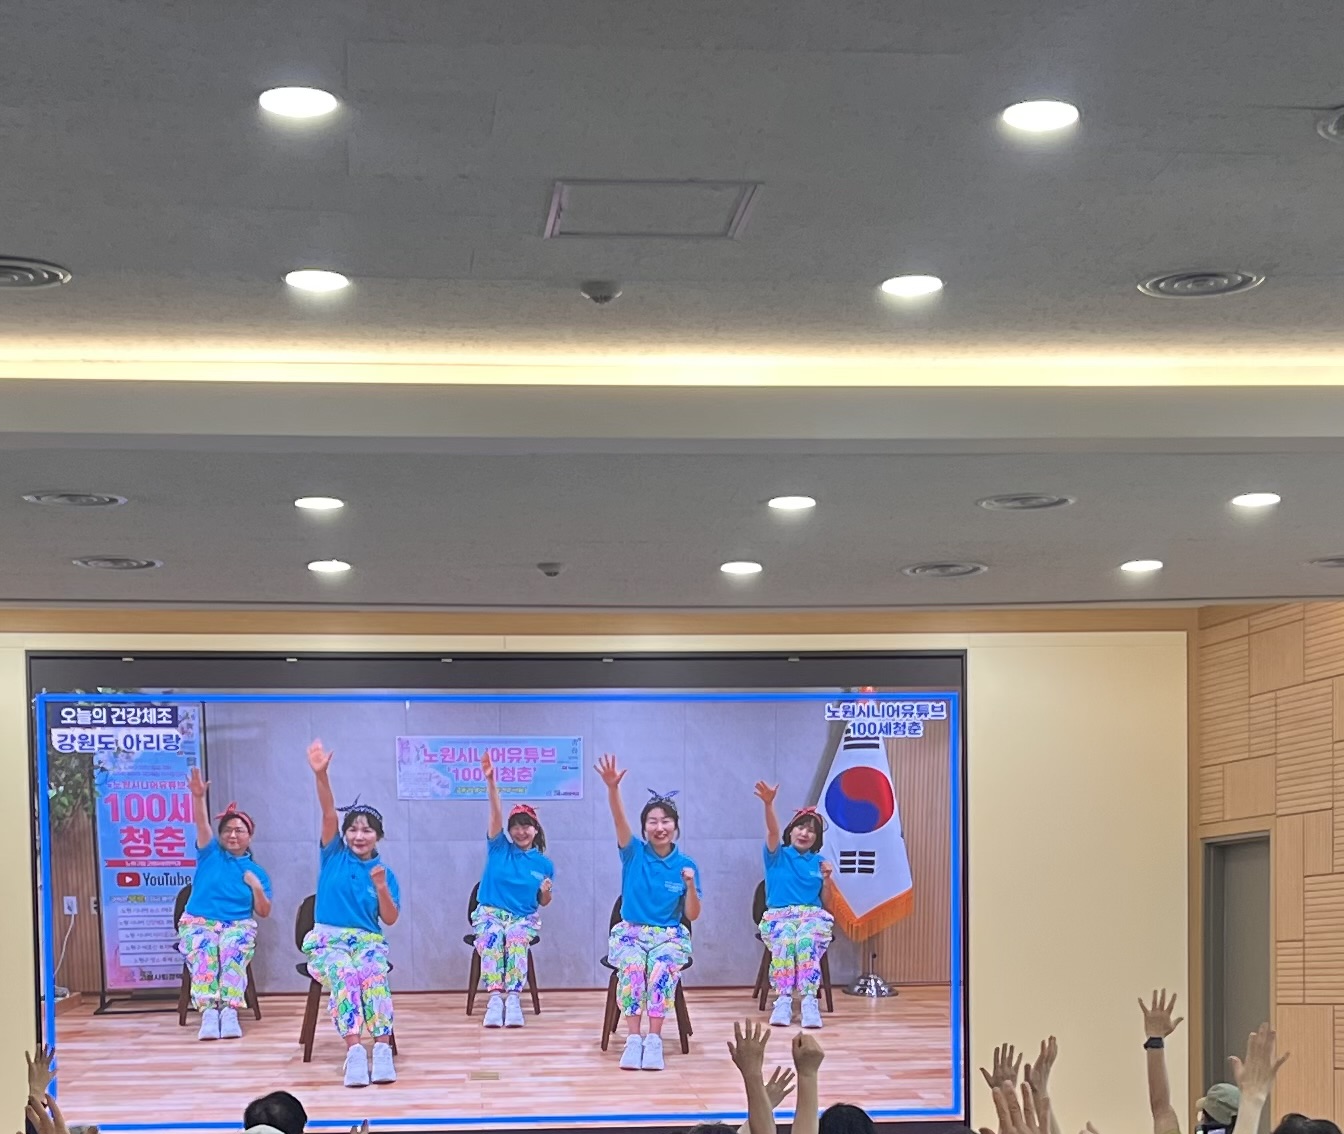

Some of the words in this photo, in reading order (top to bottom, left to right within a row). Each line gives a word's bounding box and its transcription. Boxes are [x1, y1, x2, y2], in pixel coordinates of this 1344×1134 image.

[60, 707, 107, 725] 오늘의
[110, 707, 173, 725] 건강체조
[826, 703, 945, 719] 노원시니어유튜브
[849, 721, 922, 736] 100세청춘
[56, 733, 117, 751] 강원도
[122, 733, 182, 751] 아리랑
[103, 793, 196, 823] 100세
[119, 825, 186, 858] 청춘
[142, 872, 192, 887] YouTube
